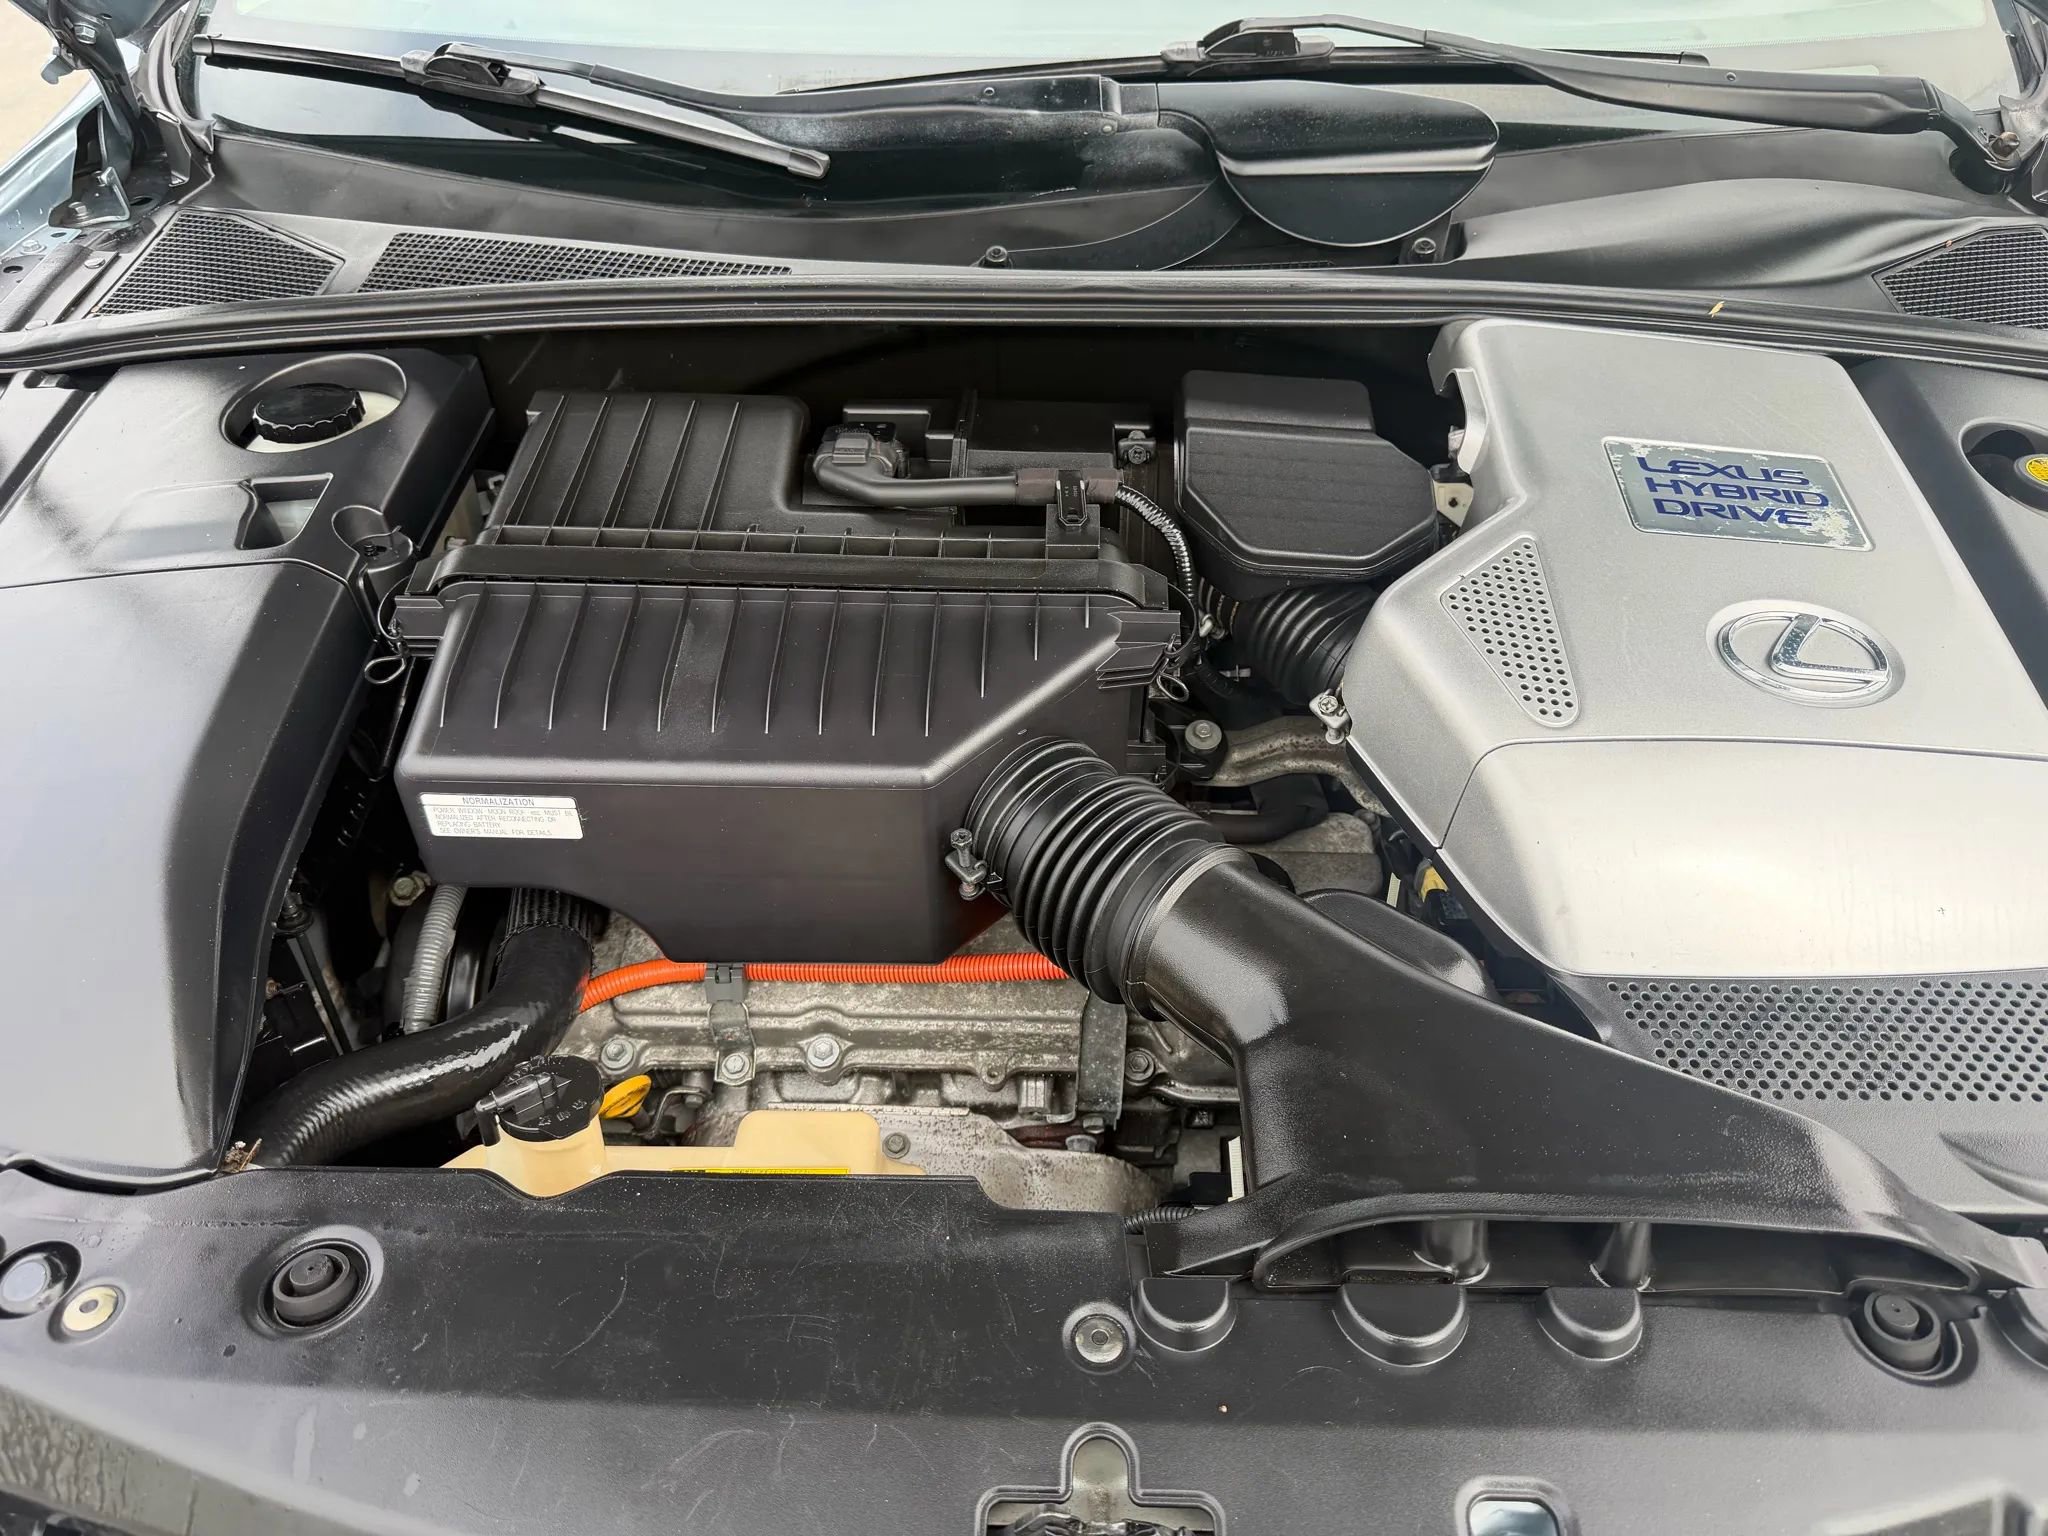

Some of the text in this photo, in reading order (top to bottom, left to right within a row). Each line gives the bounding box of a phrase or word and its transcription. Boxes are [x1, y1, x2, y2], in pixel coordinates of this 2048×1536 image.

[1636, 456, 1811, 486] LEXUS
[1644, 476, 1830, 508] HYBRID
[1652, 498, 1813, 527] DRIVE
[462, 796, 535, 807] NORMALIZATION
[434, 814, 474, 822] NORMALIZED
[476, 814, 497, 823] AFTER
[498, 815, 545, 824] RECONNECTING
[543, 810, 562, 818] MUST
[437, 820, 471, 828] REPLACING
[439, 826, 452, 834] SEE
[483, 827, 510, 836] MANUAL
